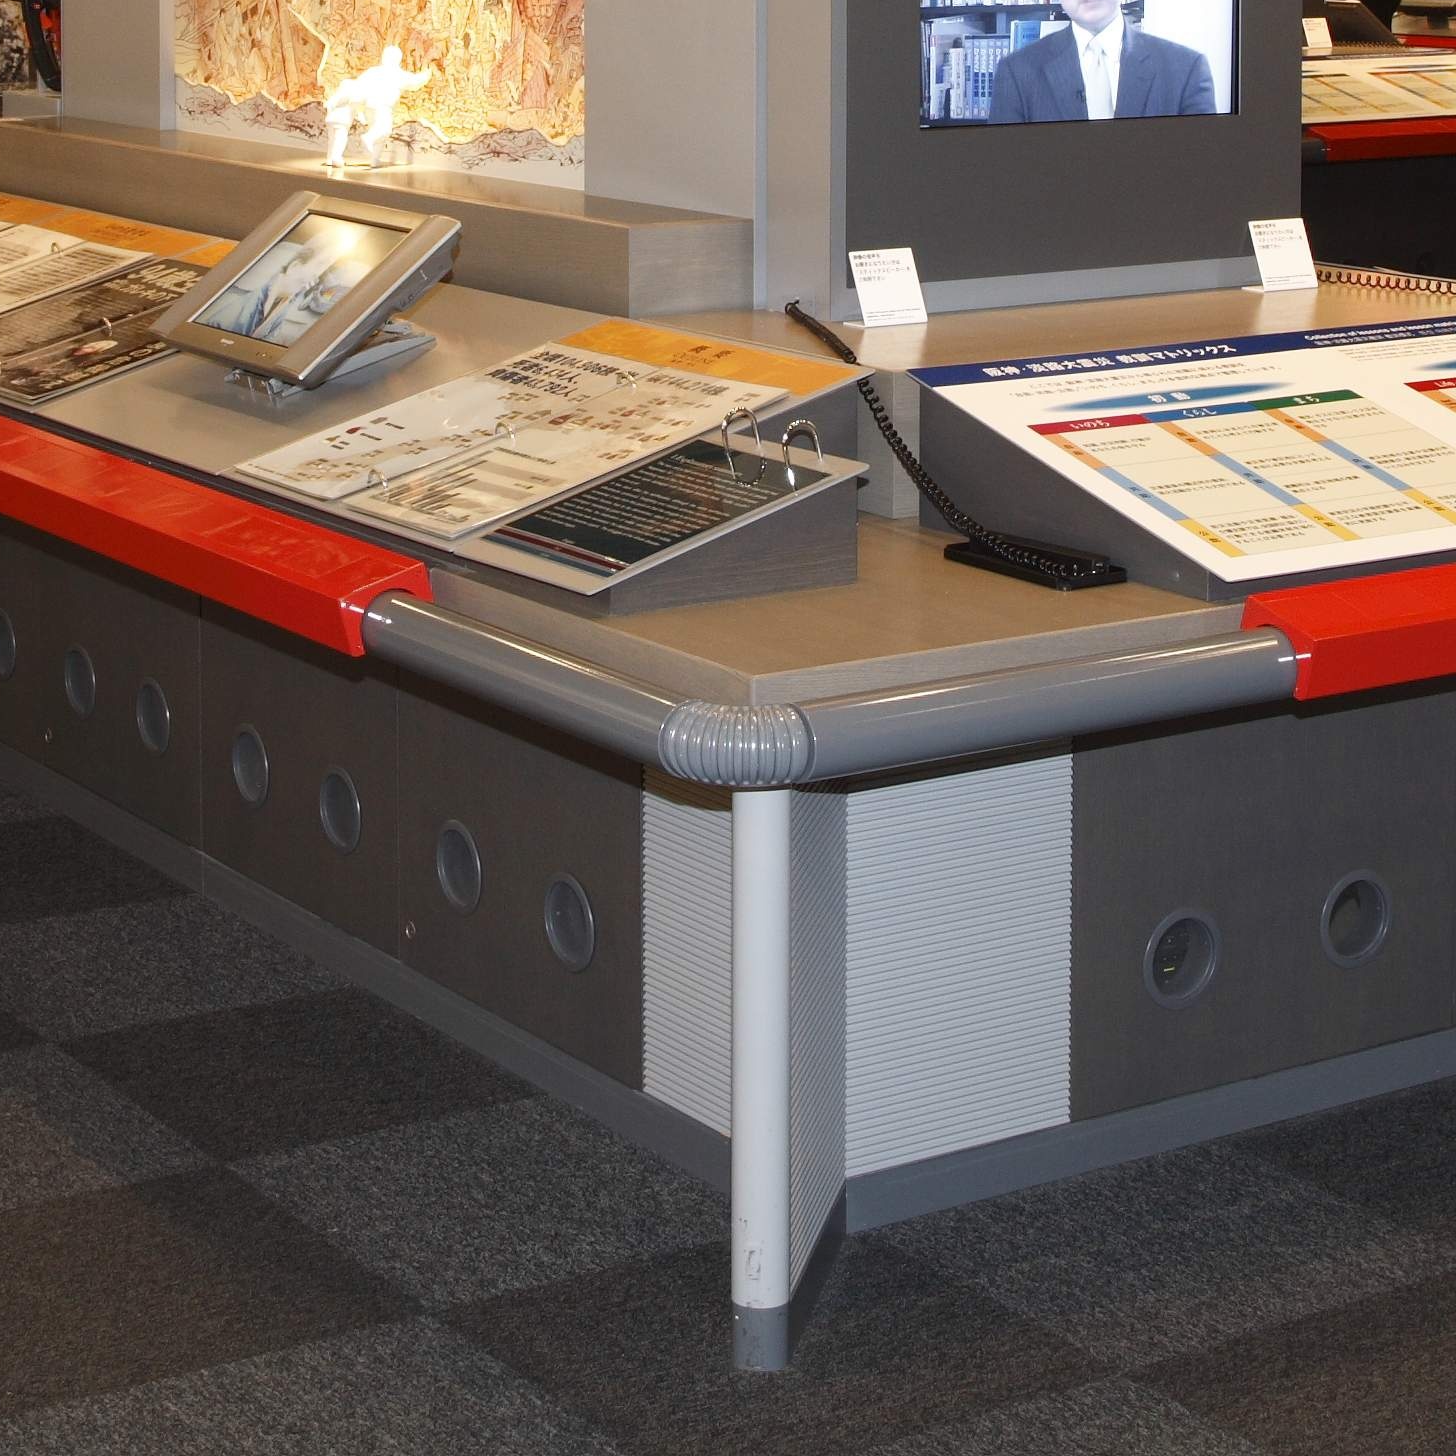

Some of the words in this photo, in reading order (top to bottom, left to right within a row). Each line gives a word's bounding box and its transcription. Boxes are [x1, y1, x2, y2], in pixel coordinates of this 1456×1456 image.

[1292, 395, 1321, 405] まち
[1181, 406, 1218, 418] くらし
[1070, 418, 1111, 431] いのち
